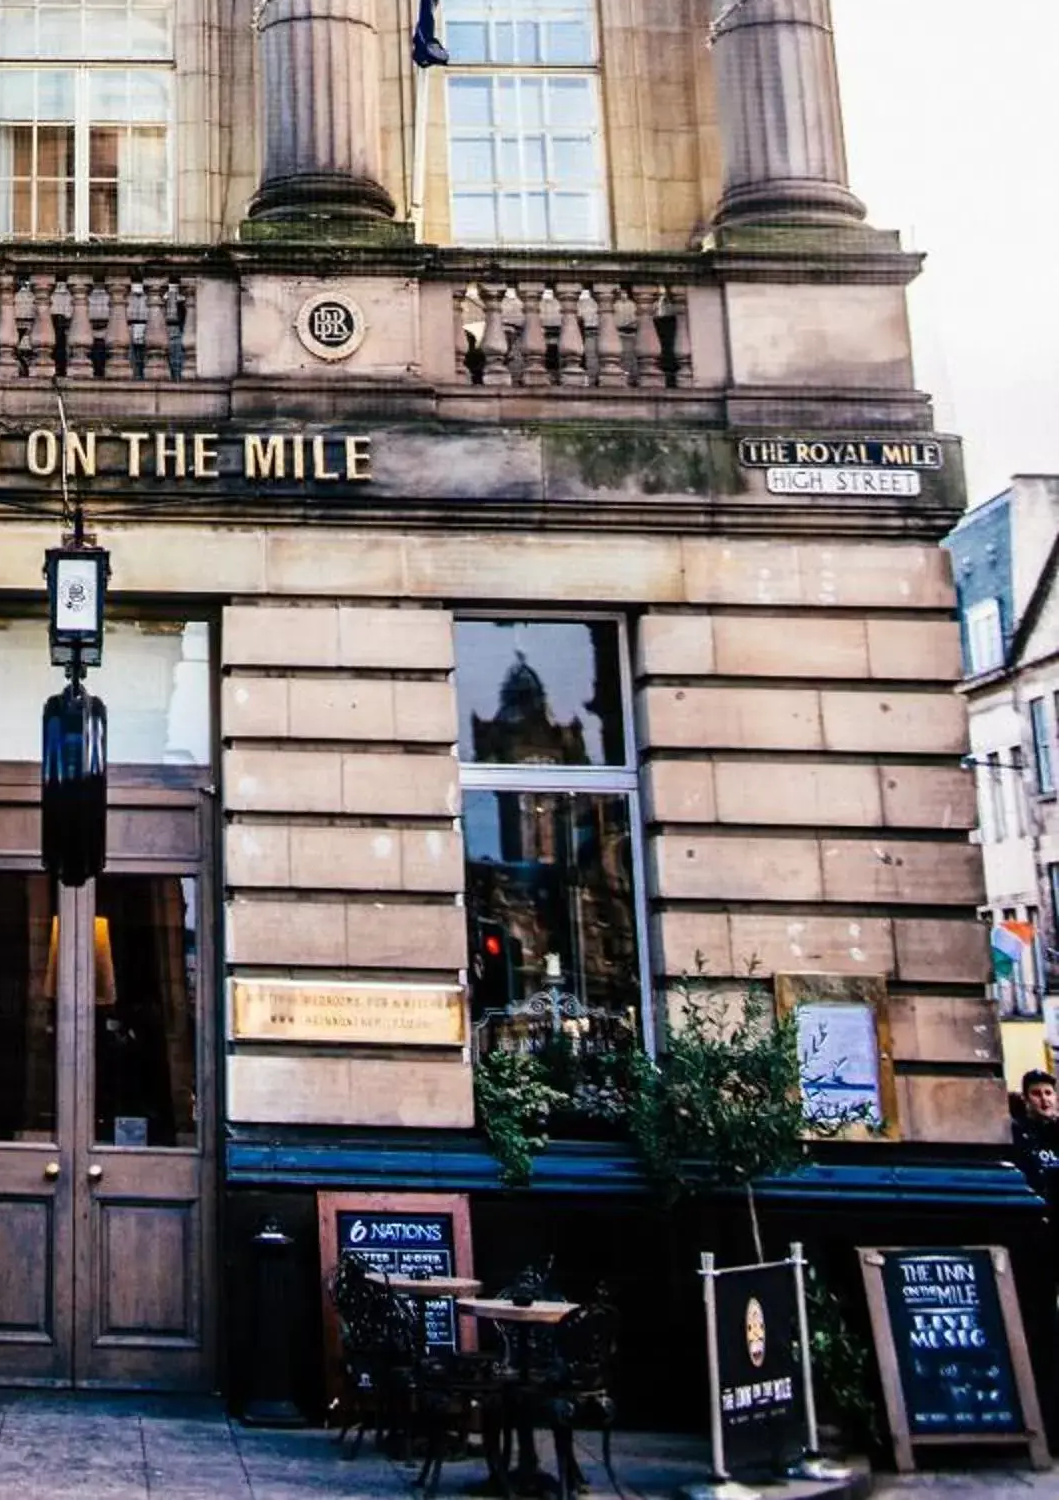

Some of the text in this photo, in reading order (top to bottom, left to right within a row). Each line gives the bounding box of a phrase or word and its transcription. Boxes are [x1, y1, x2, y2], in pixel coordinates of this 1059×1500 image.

[28, 430, 96, 477] ON
[121, 432, 219, 480] THE
[244, 435, 373, 481] MILE
[747, 441, 937, 466] THE ROYAL MILE
[772, 471, 915, 492] HIGH STREET
[350, 1220, 442, 1243] 6 NATIONS
[900, 1264, 975, 1281] THE INN
[914, 1315, 978, 1331] LIVE
[910, 1329, 986, 1349] MUSIC
